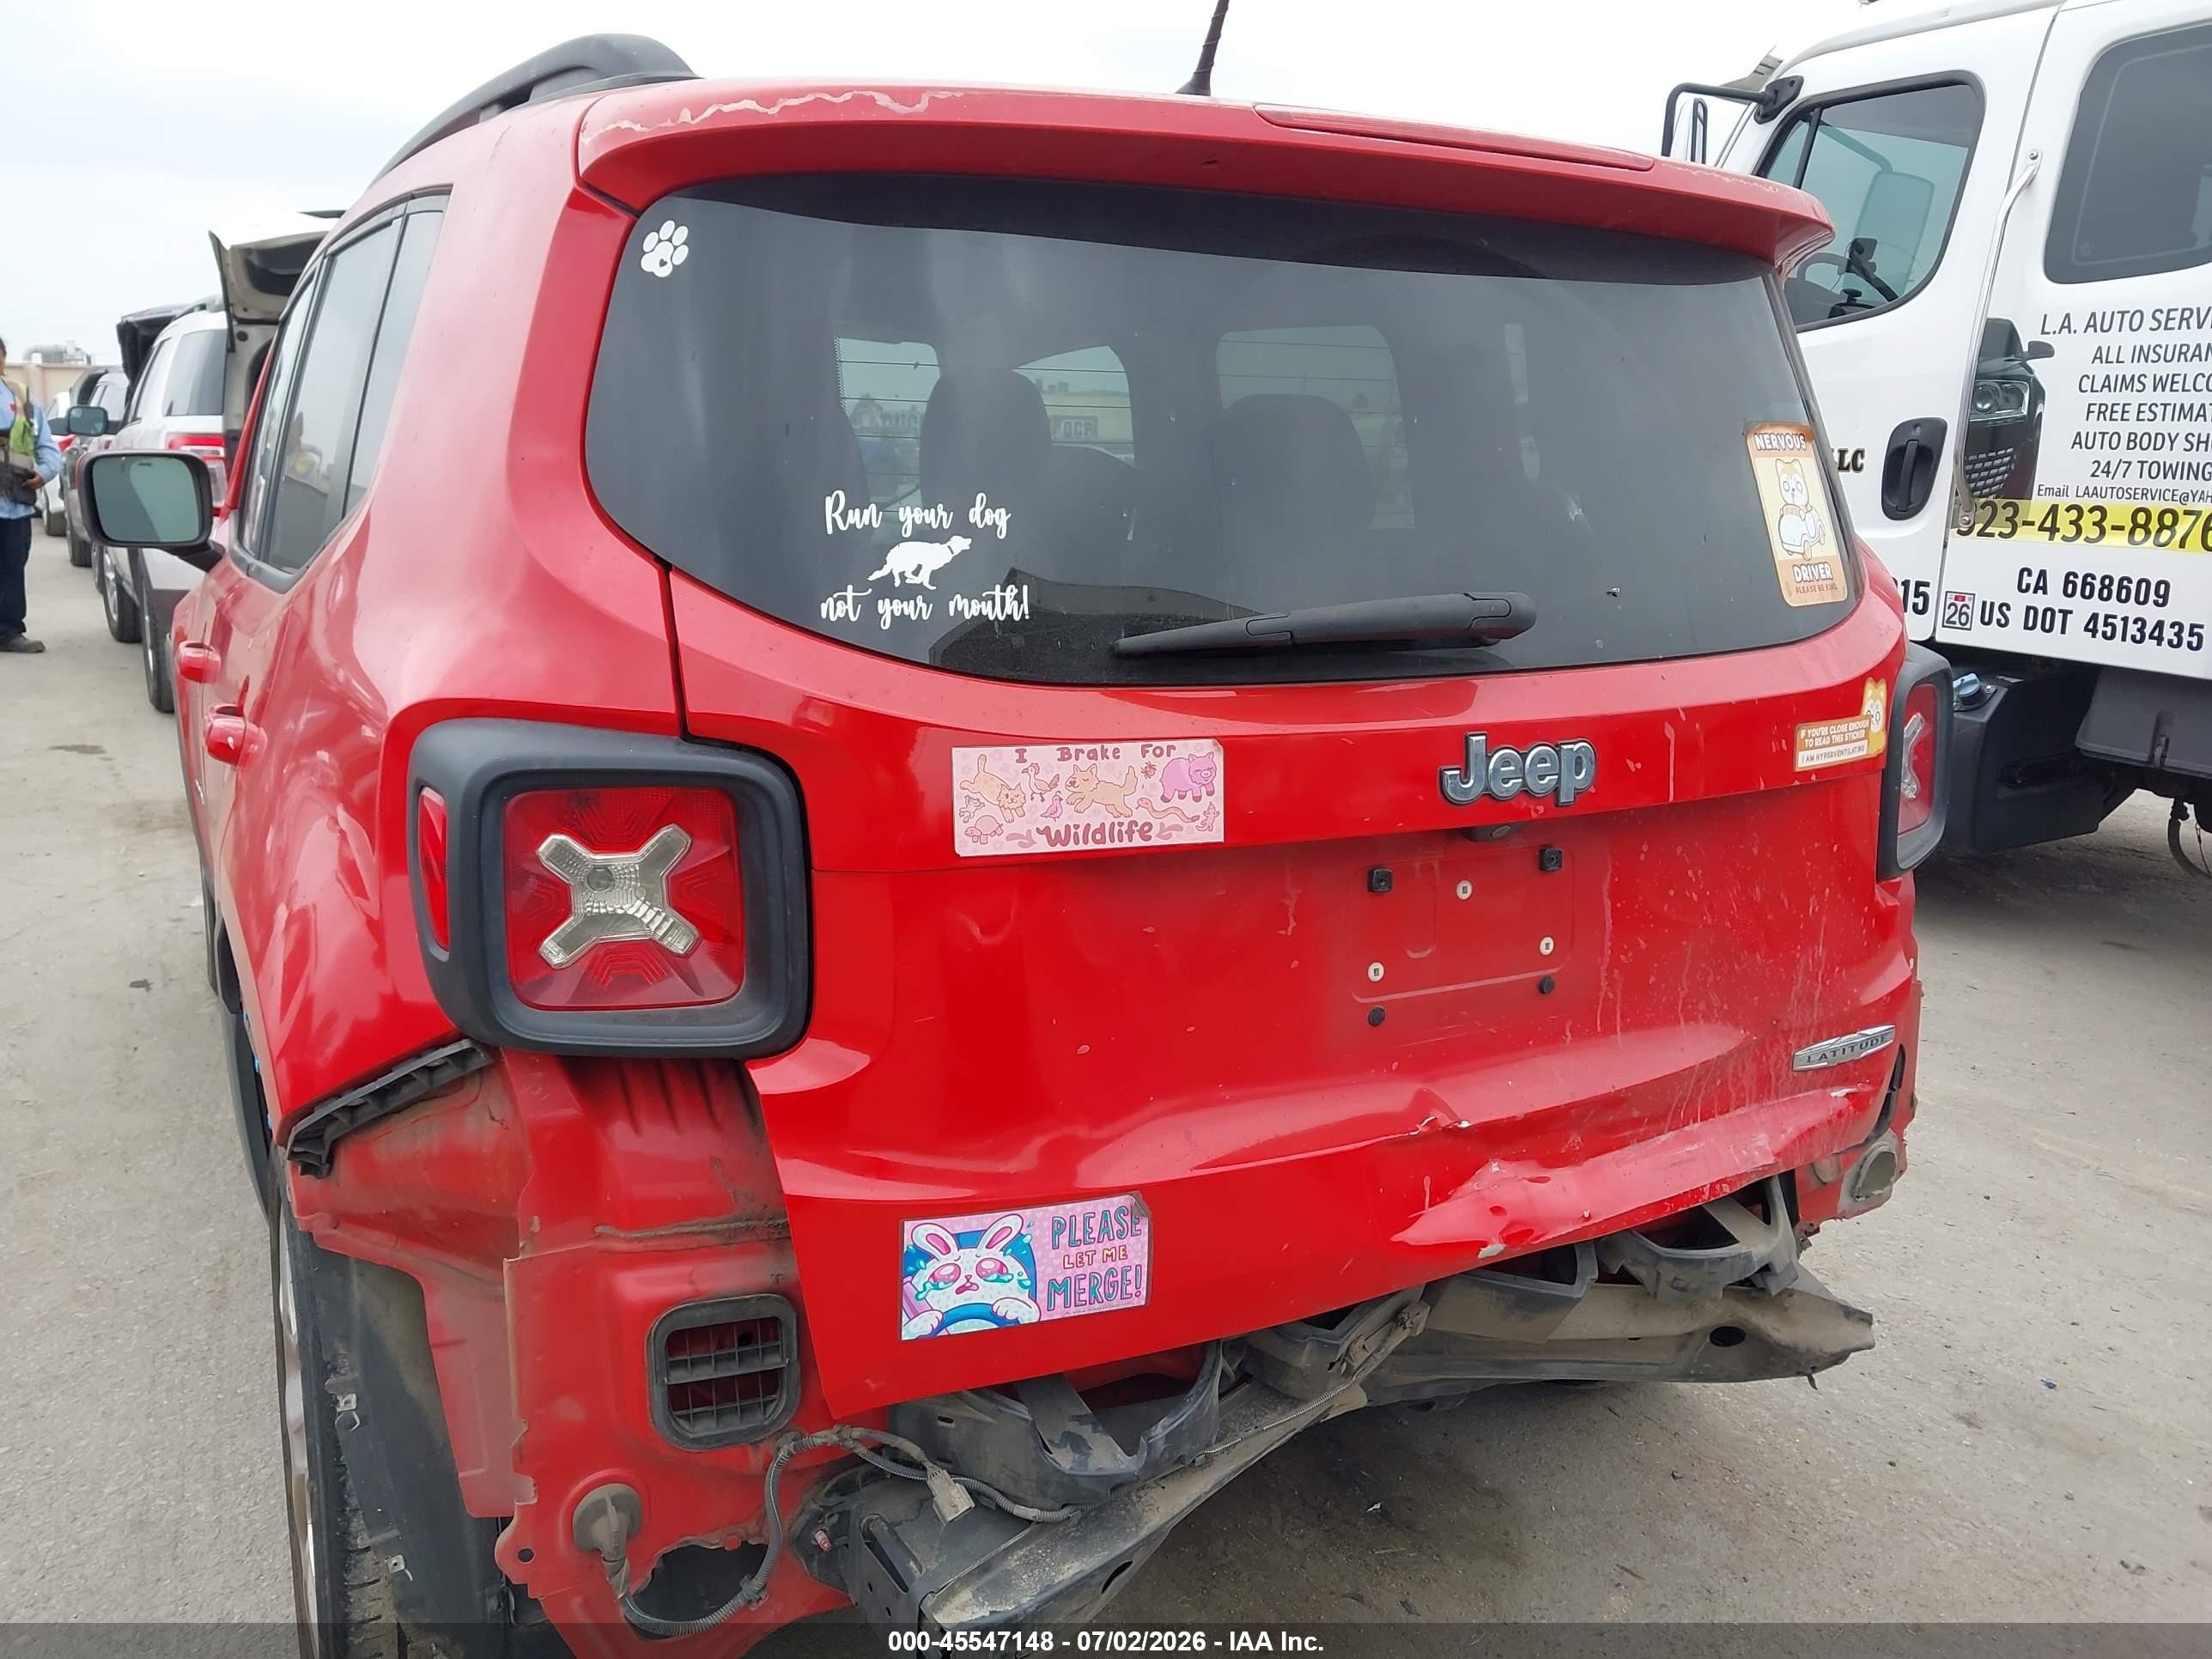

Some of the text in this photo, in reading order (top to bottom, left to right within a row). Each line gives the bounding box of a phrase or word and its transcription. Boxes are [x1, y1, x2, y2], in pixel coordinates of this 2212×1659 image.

[2040, 312, 2077, 335] L.A.
[2083, 309, 2144, 333] AUTO
[2091, 345, 2125, 364] ALL
[2078, 374, 2148, 393] CLAIMS
[2085, 403, 2132, 422] FREE
[1753, 432, 1808, 452] NERVOUS
[2070, 431, 2212, 453] AUTO BODY SH
[1831, 447, 1865, 473] LC
[2090, 459, 2212, 482] 24/7 TOWING
[2037, 483, 2069, 498] Email
[825, 489, 1012, 539] Run your dog
[1792, 562, 1833, 583] DRIVER
[1891, 576, 1931, 616] 15
[2017, 567, 2171, 608] CA 668609
[821, 584, 1030, 630] not your mouth!
[1946, 602, 1971, 627] 26
[1980, 600, 2205, 652] US DOT 4513435
[1800, 729, 1806, 739] IF
[1829, 723, 1848, 734] CLOSE
[1848, 720, 1869, 732] ENOUGH
[1805, 729, 1866, 748] TO READ THIS STICKER
[1014, 743, 1176, 763] I Brake For
[1806, 754, 1814, 763] AM
[1439, 732, 1597, 806] Jeep
[1036, 820, 1152, 848] Wildlife
[1807, 1036, 1888, 1064] LATITUDE
[1051, 1206, 1142, 1250] PLEASE
[1062, 1245, 1128, 1270] LET ME
[1047, 1264, 1143, 1313] MERGE!
